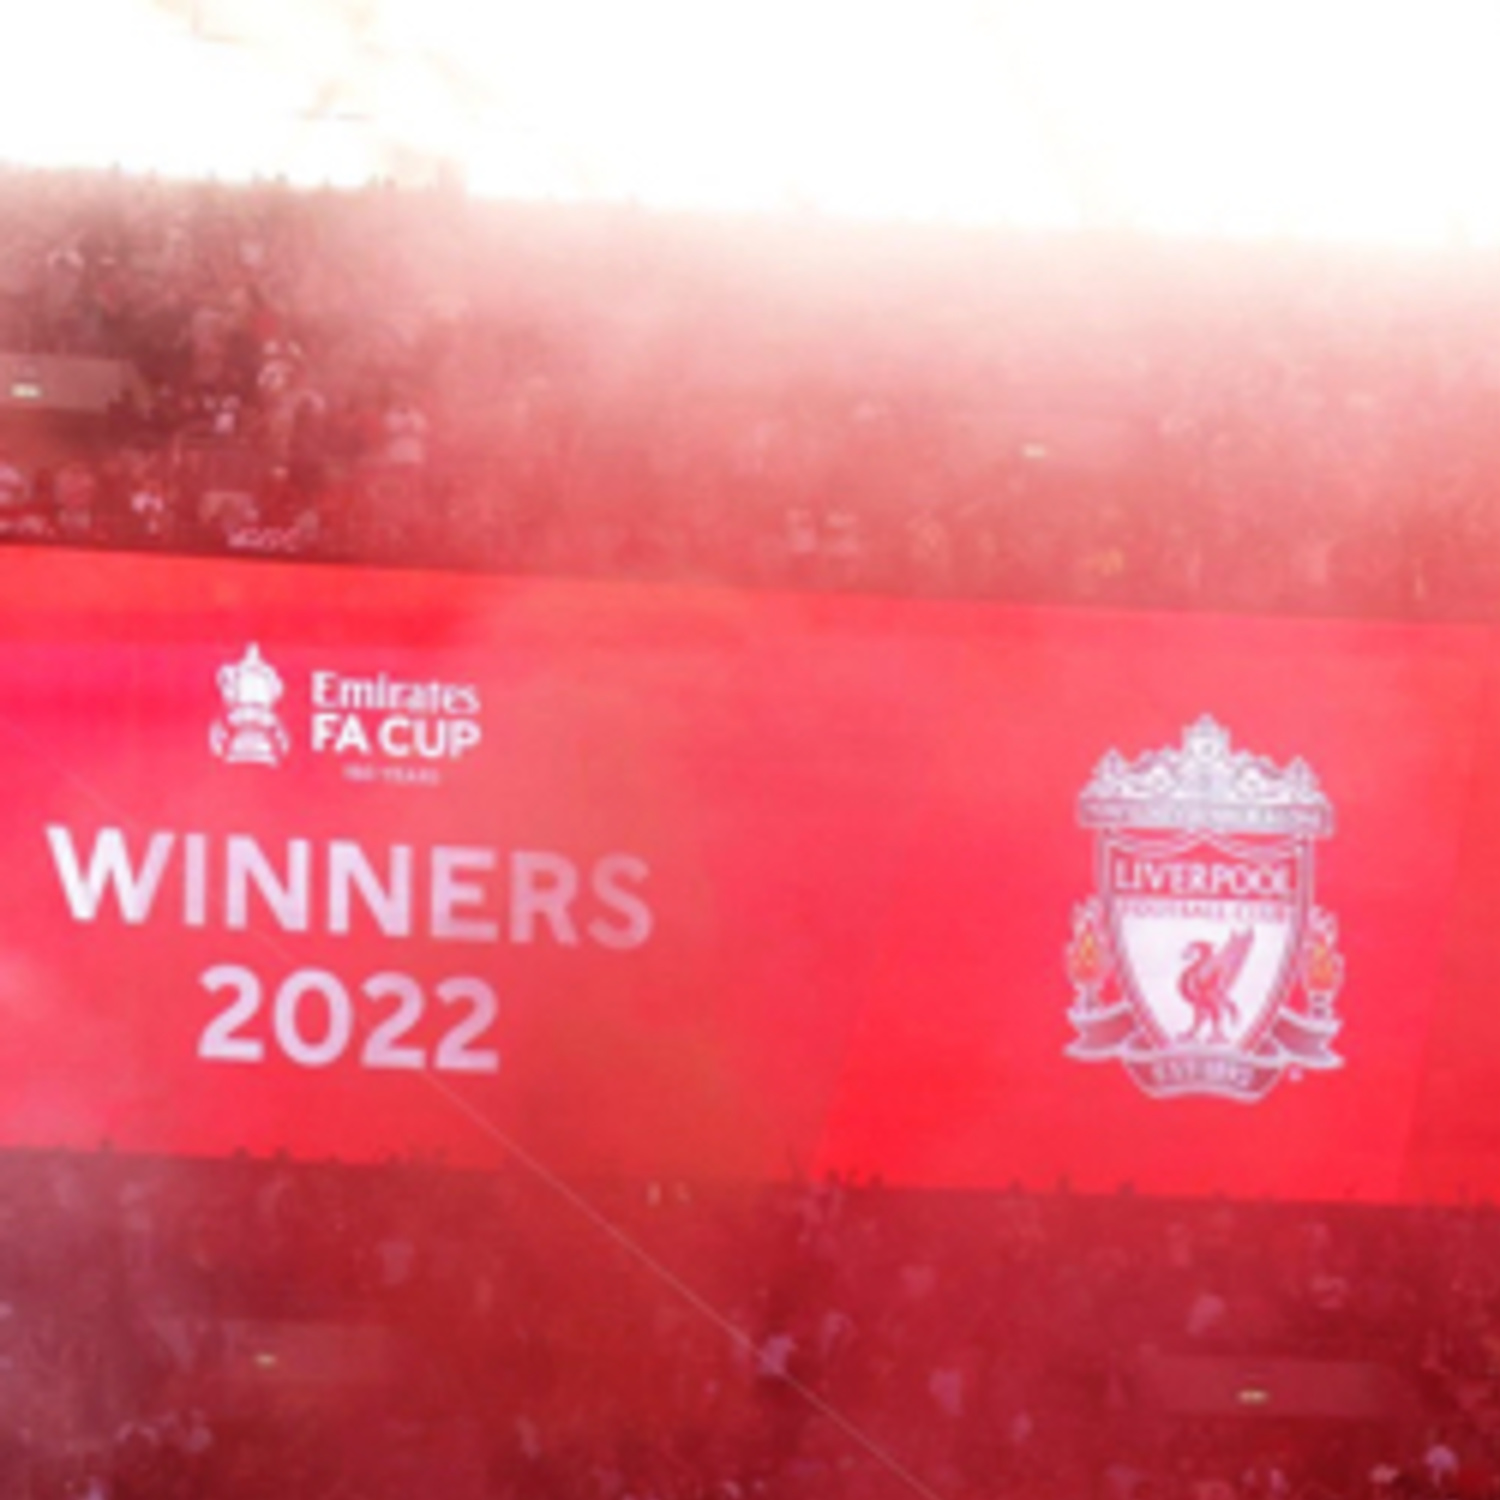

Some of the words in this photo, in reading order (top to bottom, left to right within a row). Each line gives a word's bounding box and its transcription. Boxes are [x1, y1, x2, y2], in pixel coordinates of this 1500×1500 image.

[311, 670, 481, 715] Emirates
[311, 712, 371, 755] FA
[377, 715, 482, 761] CUP
[46, 825, 652, 950] WINNERS
[1116, 861, 1290, 894] LIVERPOOL
[199, 965, 499, 1072] 2022
